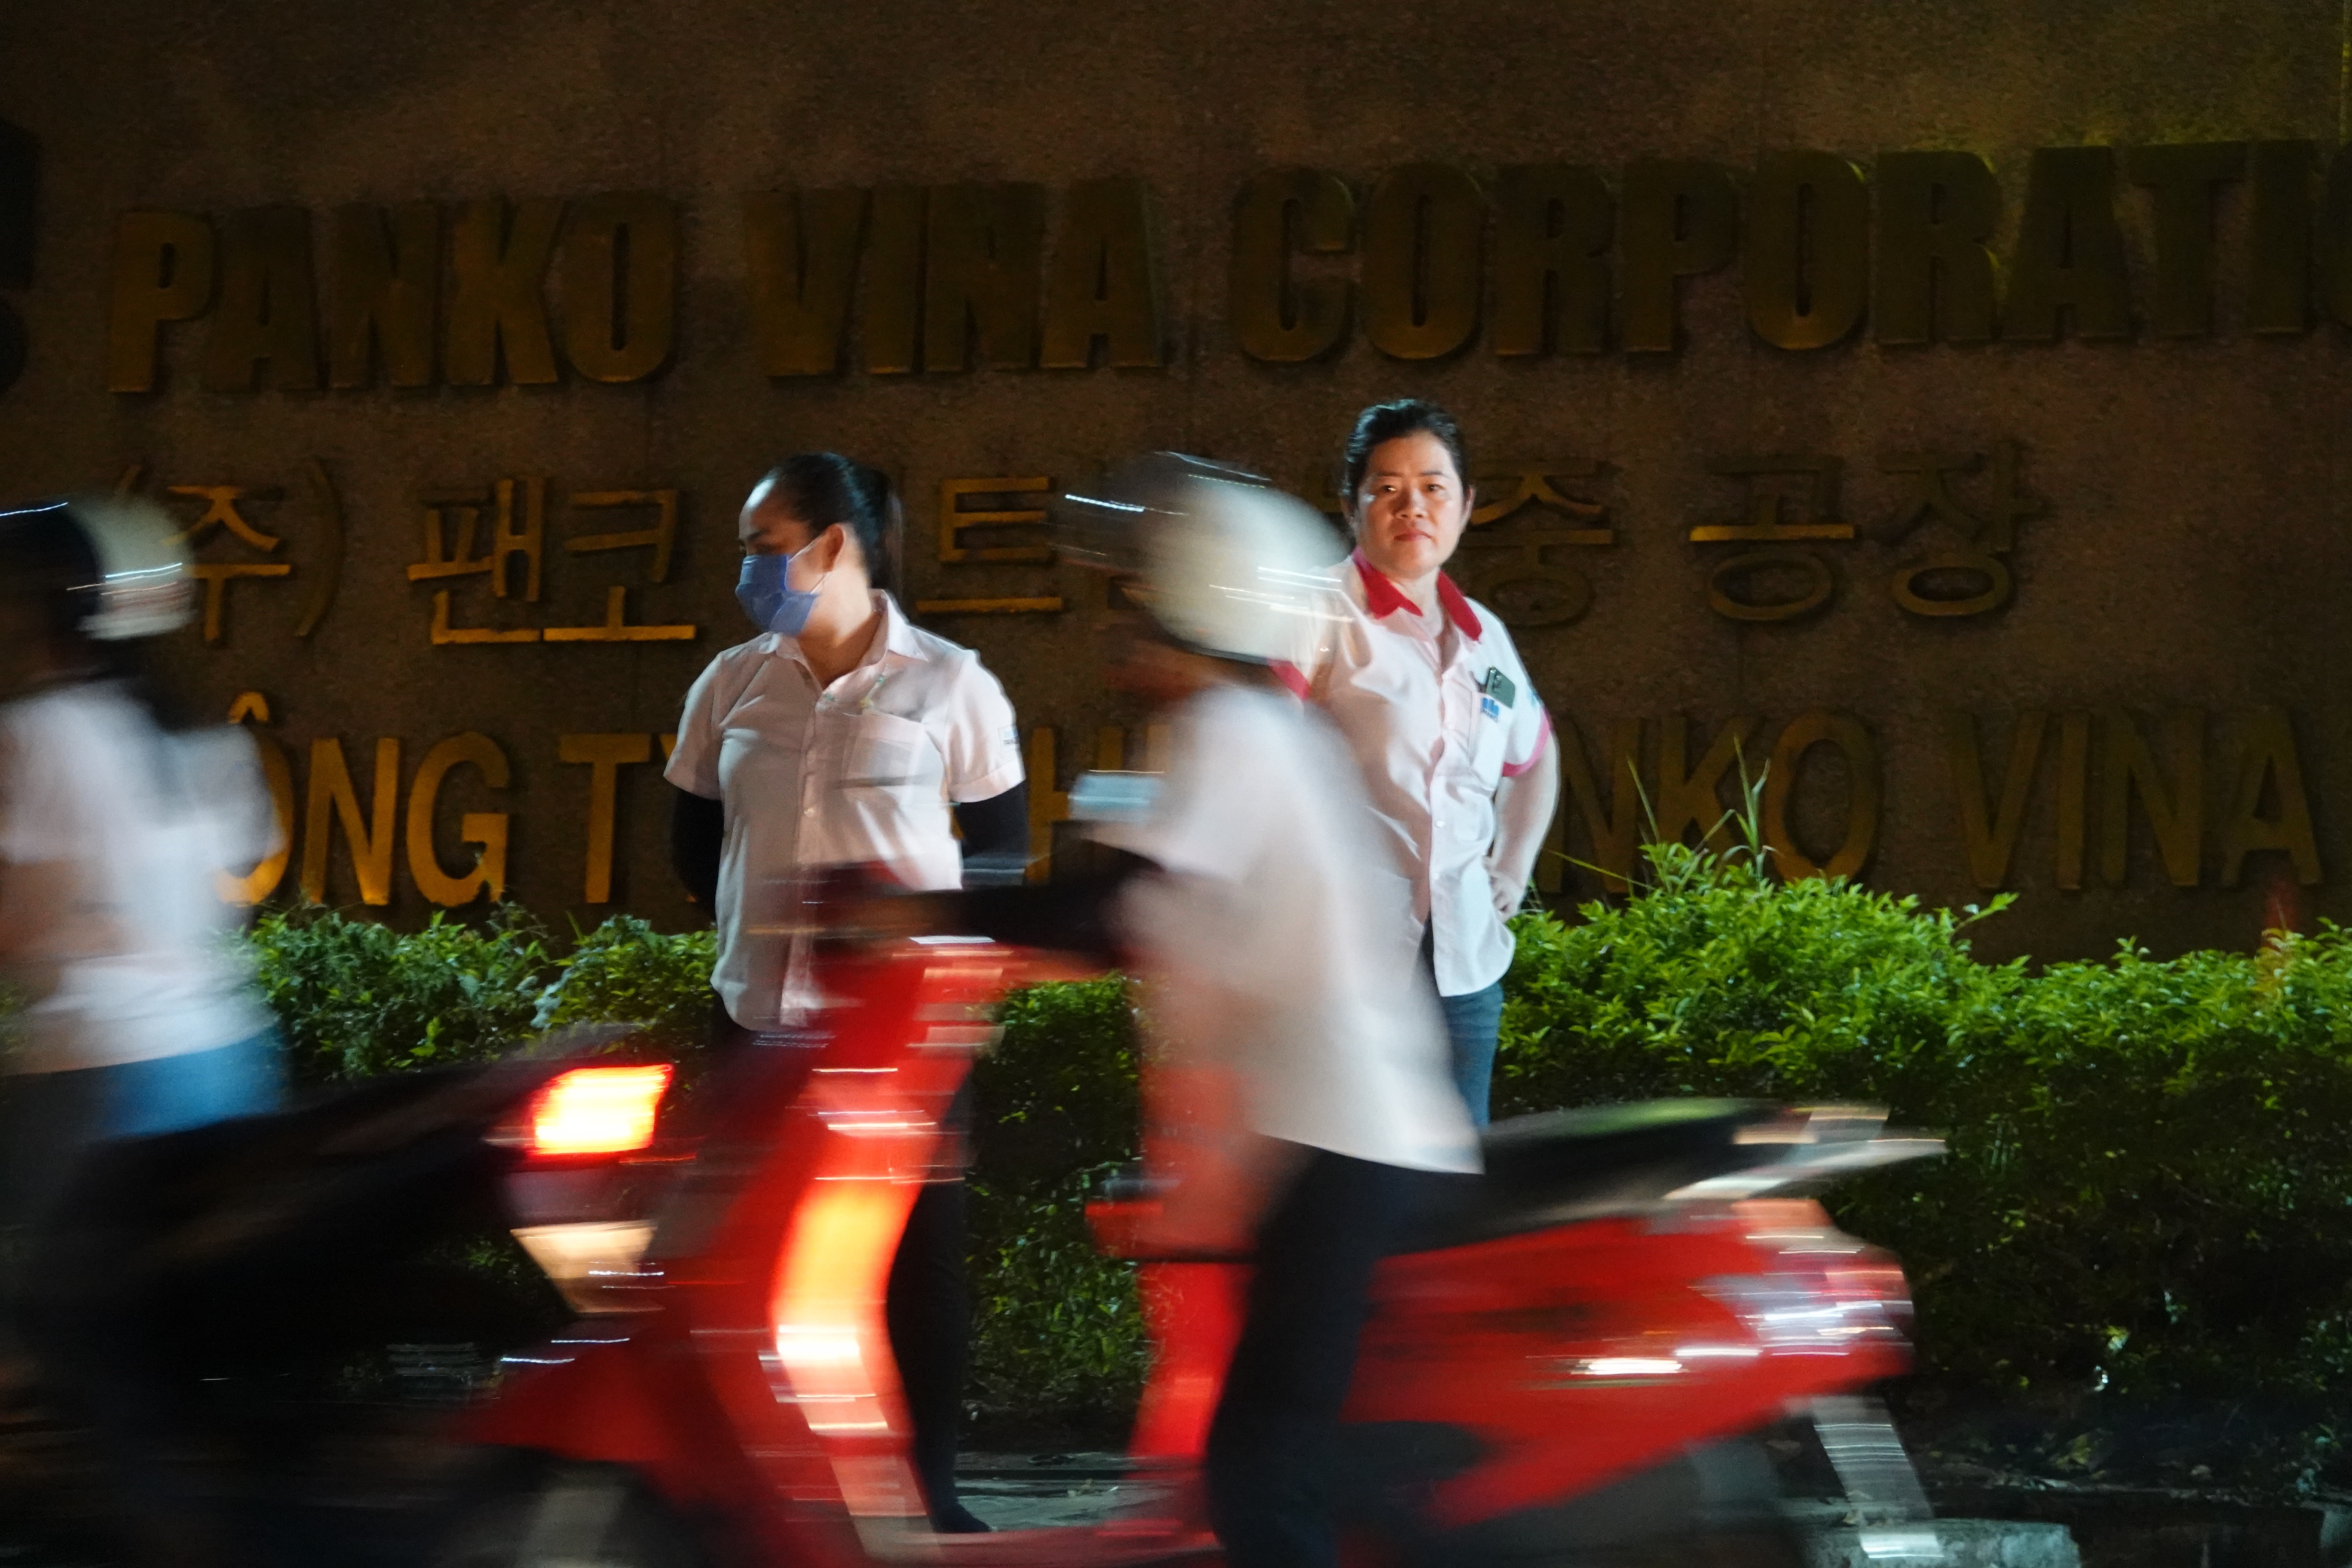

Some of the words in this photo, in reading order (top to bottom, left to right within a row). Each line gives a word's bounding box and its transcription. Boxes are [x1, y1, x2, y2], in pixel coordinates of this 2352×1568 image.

[107, 190, 683, 393] PANKO
[746, 177, 1167, 377] VINA
[1230, 141, 2352, 362] CORPORATI
[407, 475, 697, 645] 팬코
[1688, 443, 2043, 622] 공장
[218, 691, 511, 908] ÔNG
[1537, 711, 1875, 896] NKO
[1945, 707, 2323, 891] VINA
